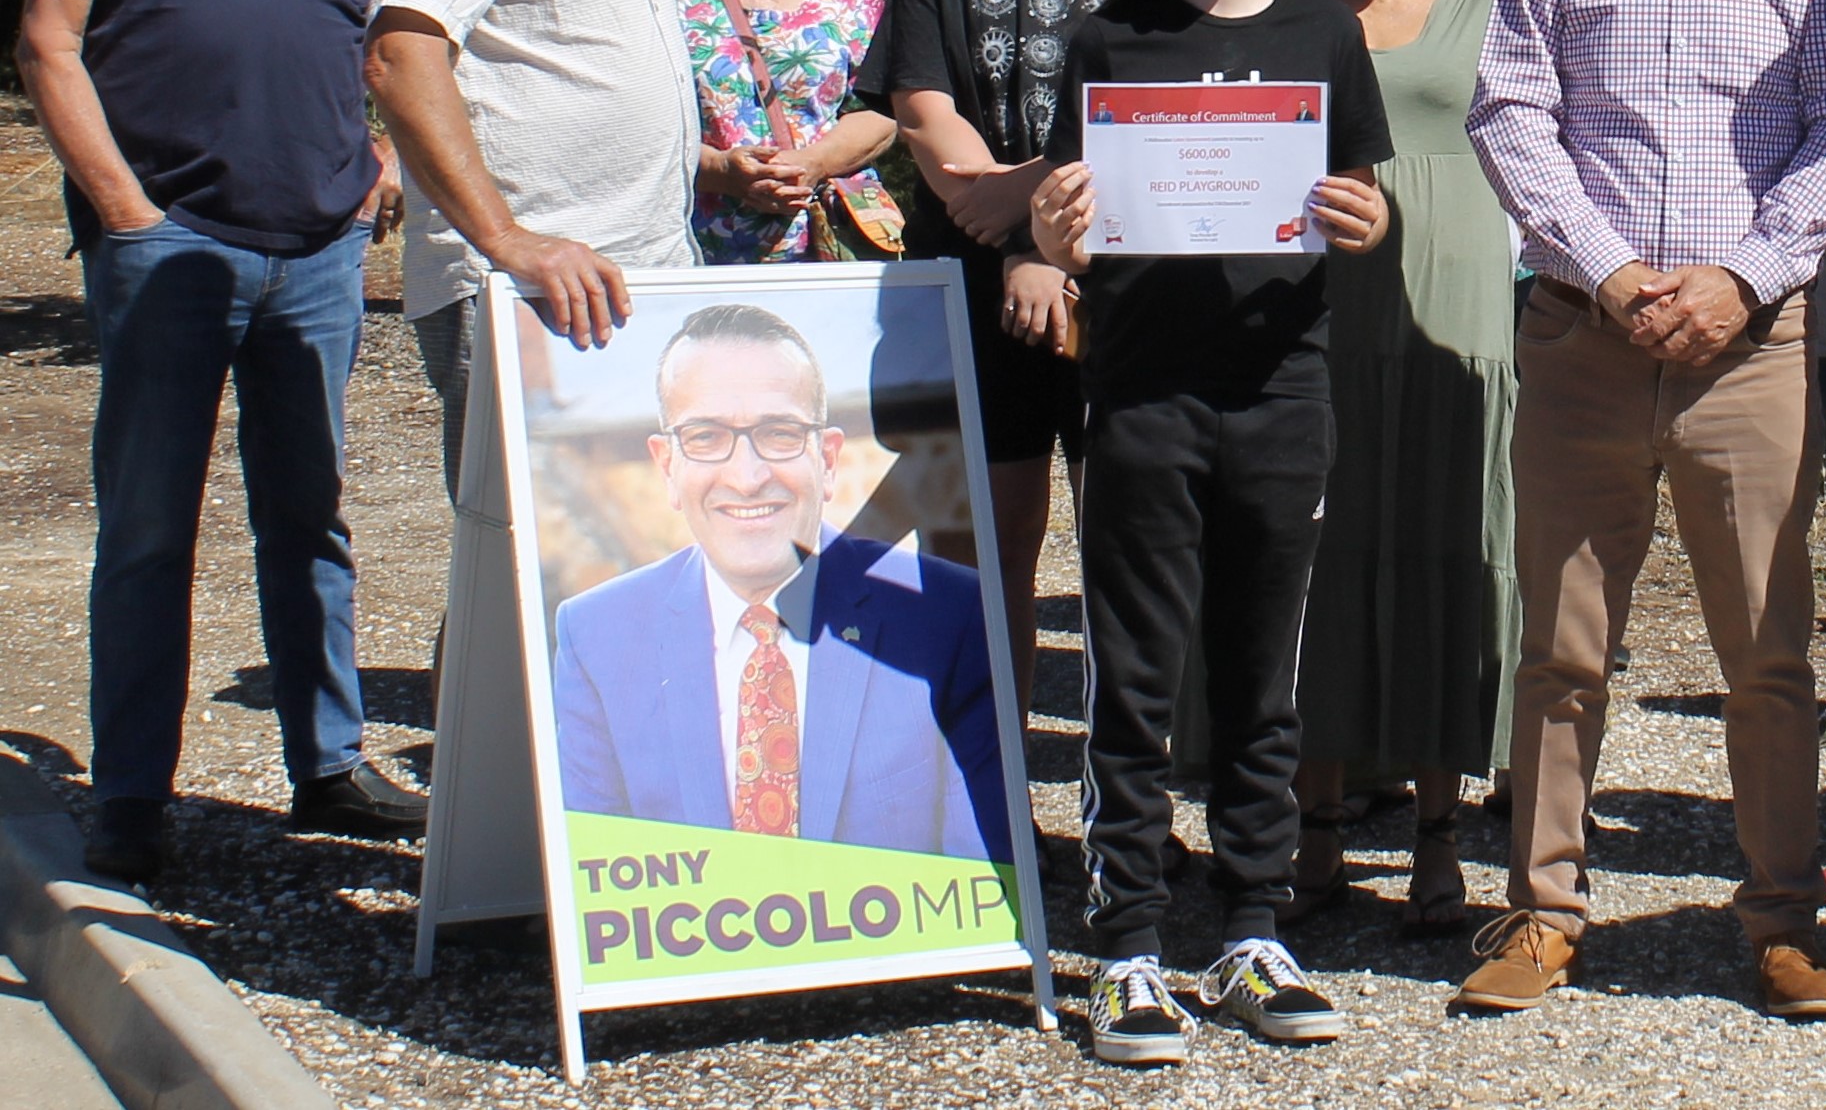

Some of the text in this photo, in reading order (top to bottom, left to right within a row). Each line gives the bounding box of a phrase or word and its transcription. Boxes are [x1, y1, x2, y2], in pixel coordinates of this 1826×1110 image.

[1132, 110, 1276, 123] Certificate of Commitment
[1178, 148, 1231, 160] $600,000
[1149, 179, 1260, 193] REID PLAYGROUND
[578, 849, 711, 893] TONY
[583, 875, 1009, 966] PICCOLO MP
